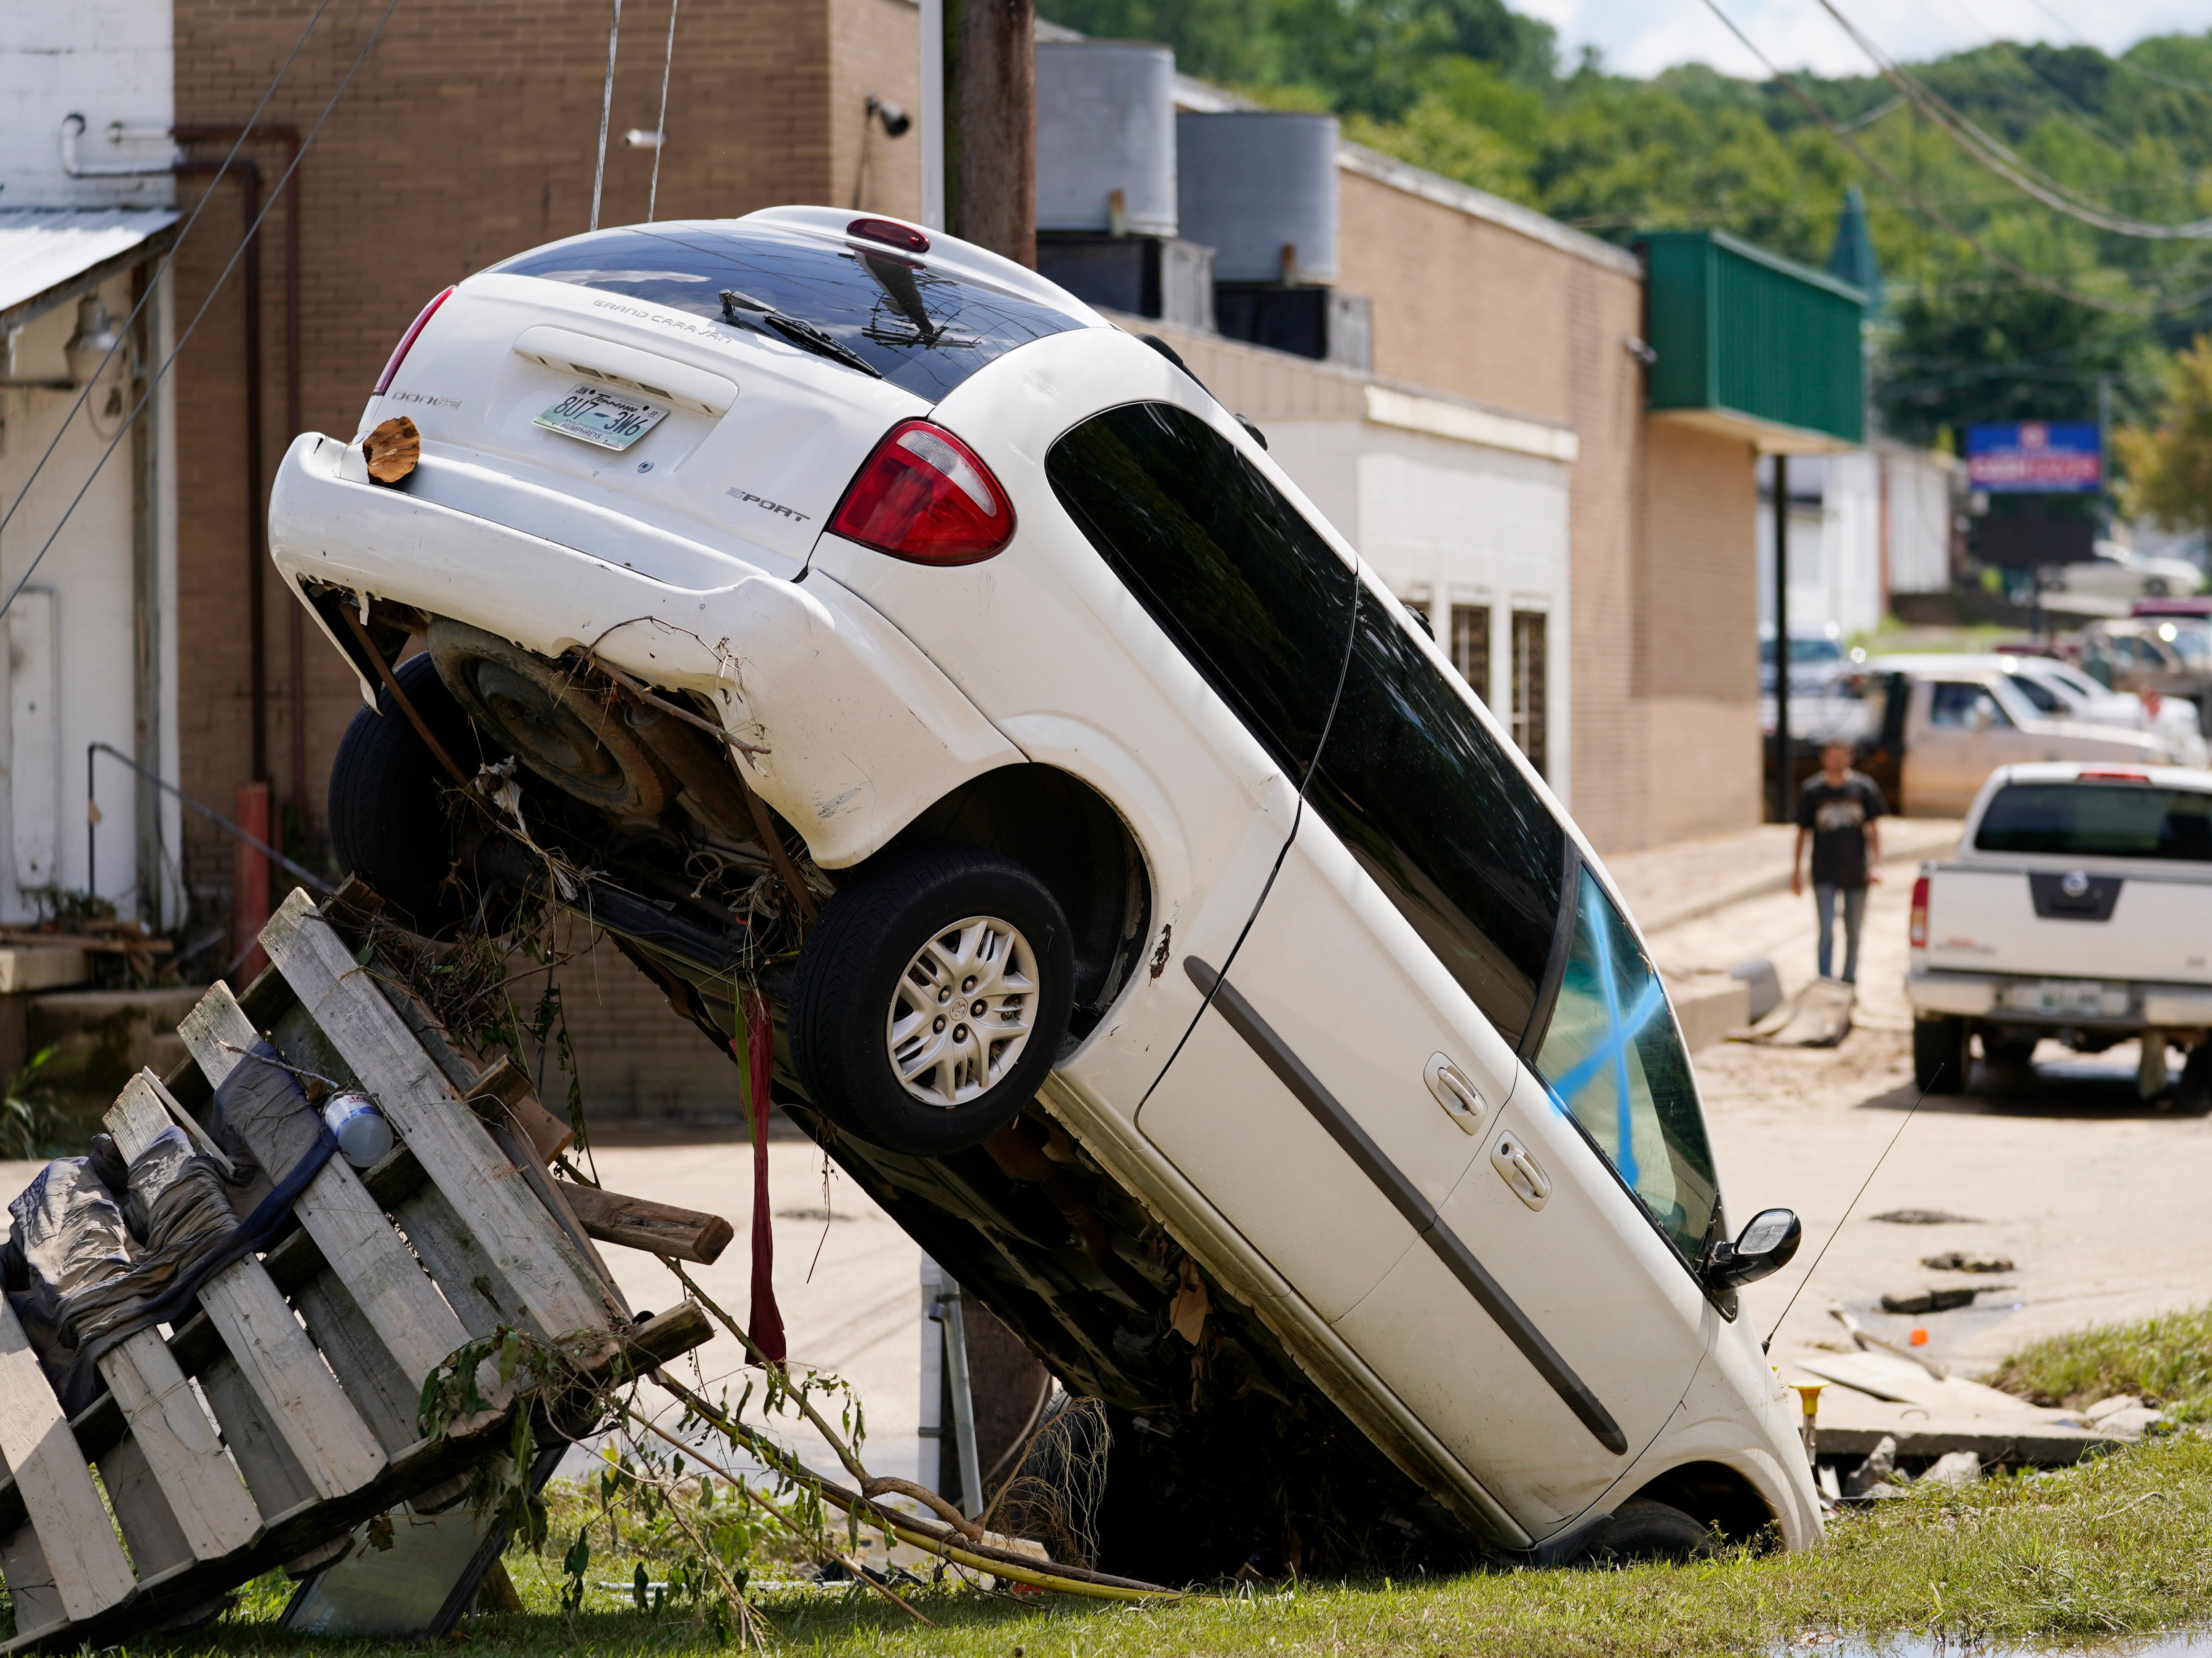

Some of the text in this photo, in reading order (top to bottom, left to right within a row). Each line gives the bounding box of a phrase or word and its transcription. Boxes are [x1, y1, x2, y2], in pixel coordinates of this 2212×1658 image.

[592, 300, 733, 344] GRAND CARAVAN
[392, 390, 462, 409] DODGE
[575, 387, 590, 395] JUN
[588, 393, 638, 413] Tennessee
[560, 422, 603, 440] HUMPHREYS
[725, 487, 811, 522] SPORT
